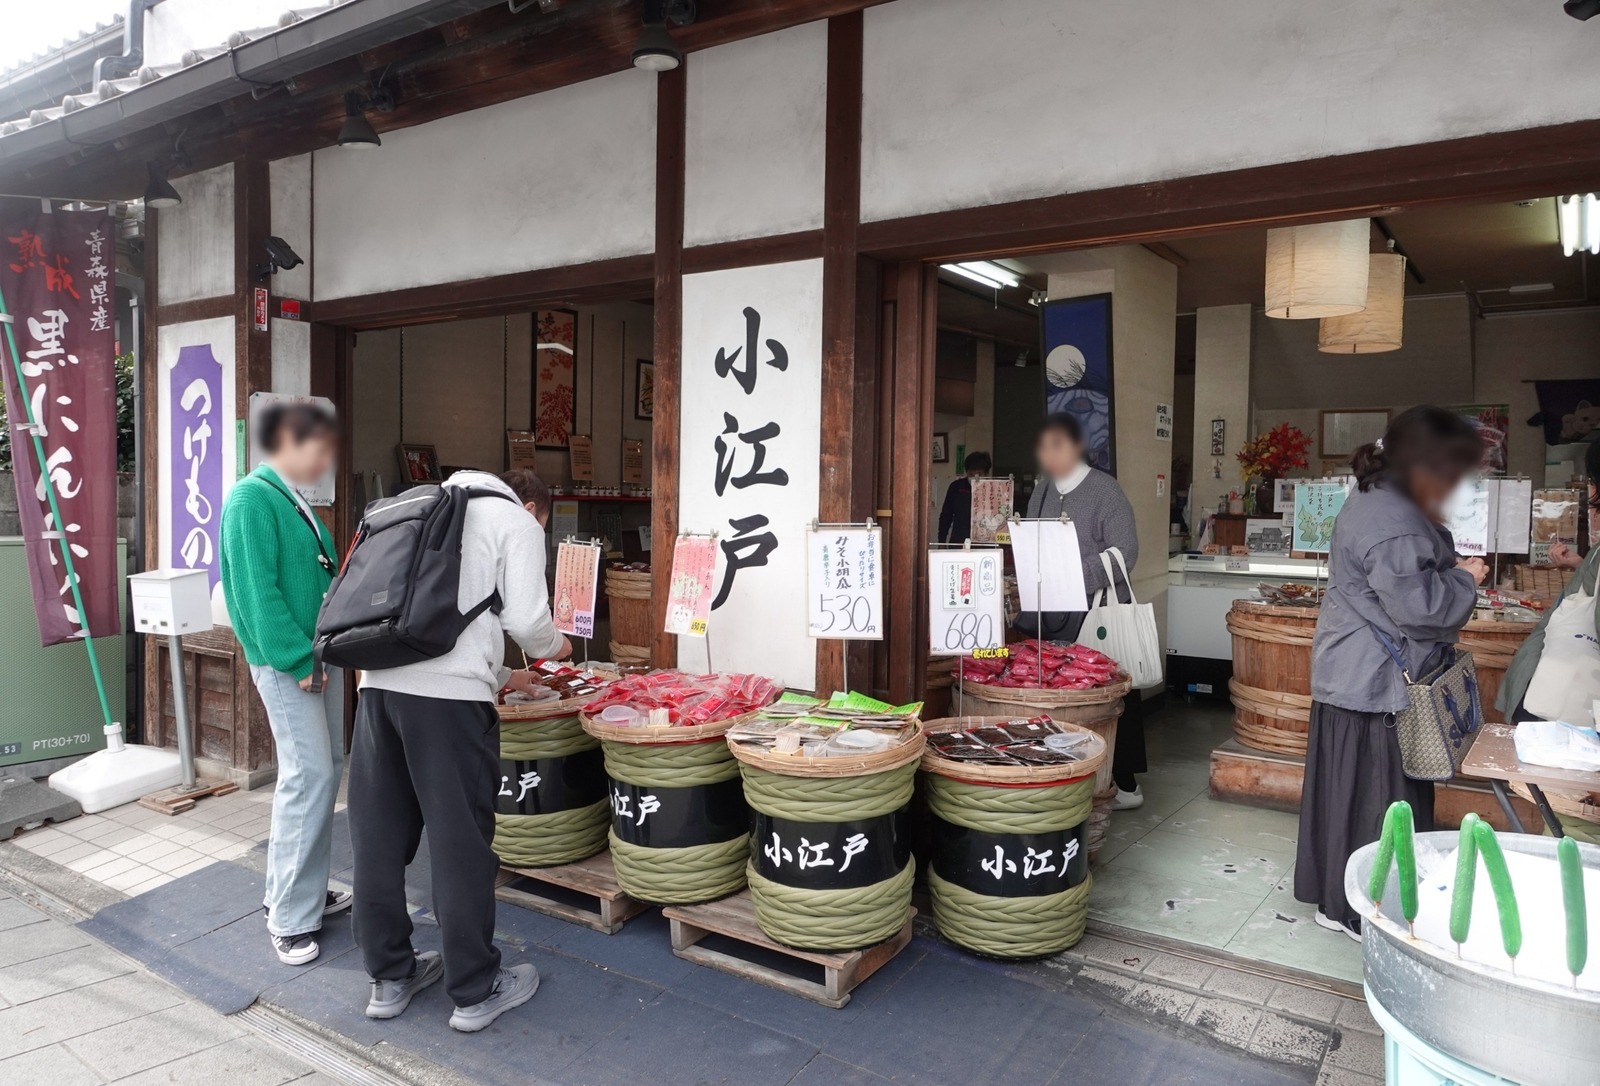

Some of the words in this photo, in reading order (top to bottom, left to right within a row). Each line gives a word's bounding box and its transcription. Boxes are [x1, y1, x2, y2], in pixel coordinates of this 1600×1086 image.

[8, 230, 80, 300] 熟成
[85, 228, 111, 332] 青森県産
[180, 377, 214, 569] つけもの
[711, 306, 790, 611] 小江戸
[835, 536, 852, 590] みそ小胡瓜
[575, 615, 592, 625] 600円
[575, 626, 592, 637] 750円
[32, 733, 91, 751] PT(30+70)
[764, 831, 870, 873] 小江戸
[981, 838, 1081, 880] 小江戸
